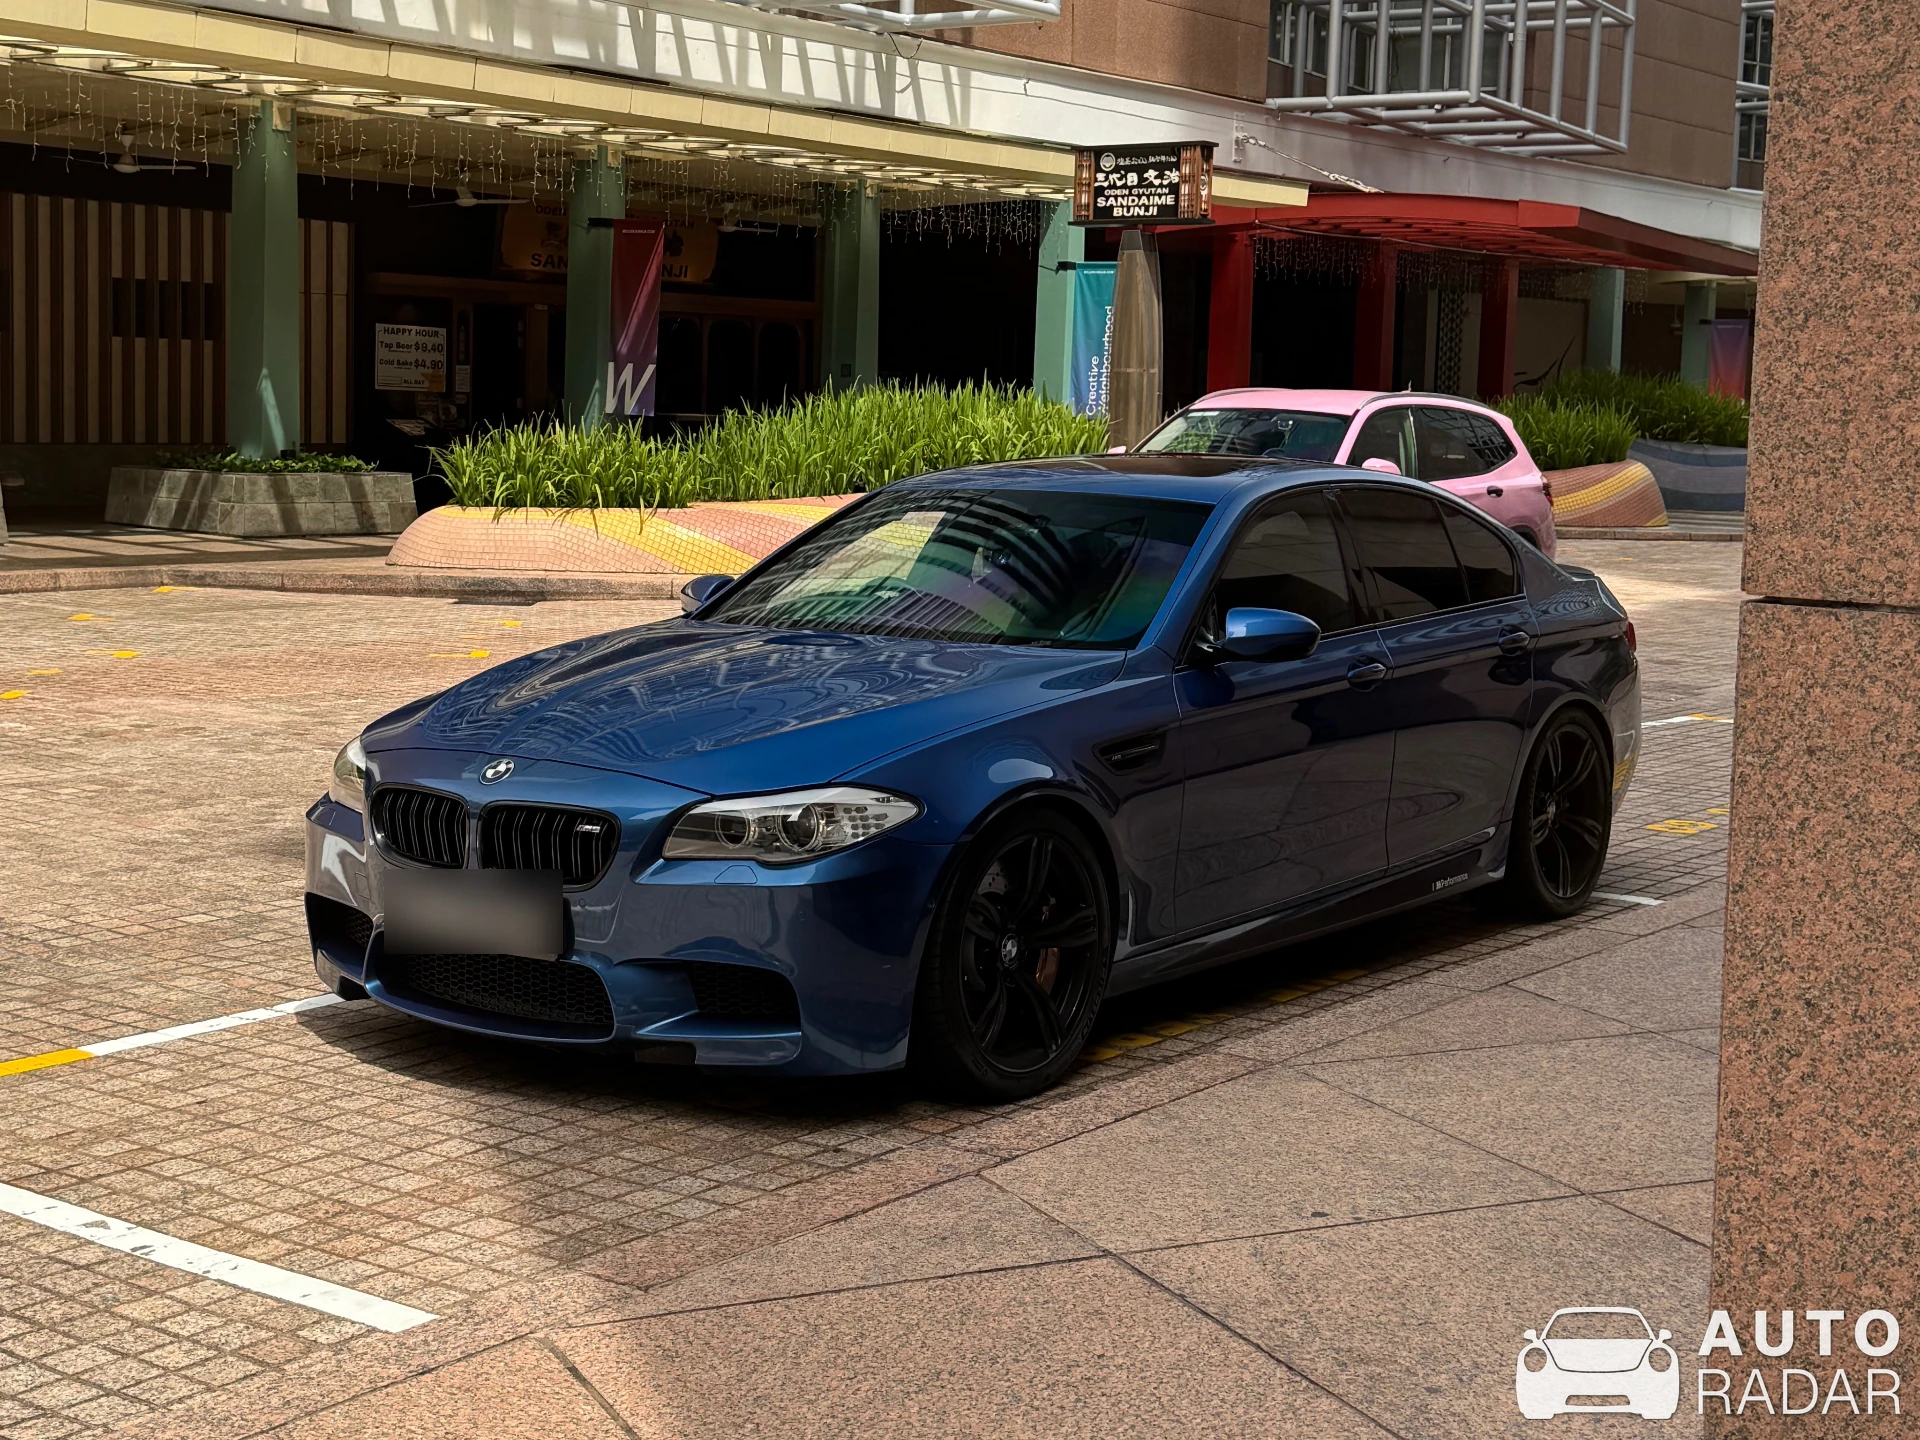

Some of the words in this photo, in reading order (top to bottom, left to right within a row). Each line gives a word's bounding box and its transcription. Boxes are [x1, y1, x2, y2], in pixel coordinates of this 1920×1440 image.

[1104, 188, 1129, 196] ODEN
[1131, 187, 1169, 195] GYUTAN
[1096, 195, 1176, 207] SANDAIME
[1112, 206, 1158, 217] BUNJI
[383, 326, 413, 336] HAPPY
[415, 328, 440, 339] HOUR
[379, 341, 394, 352] Tap
[395, 342, 413, 350] Beer
[379, 358, 395, 366] Cold
[396, 359, 413, 367] Sake
[604, 361, 657, 416] W
[1085, 355, 1100, 416] Creative
